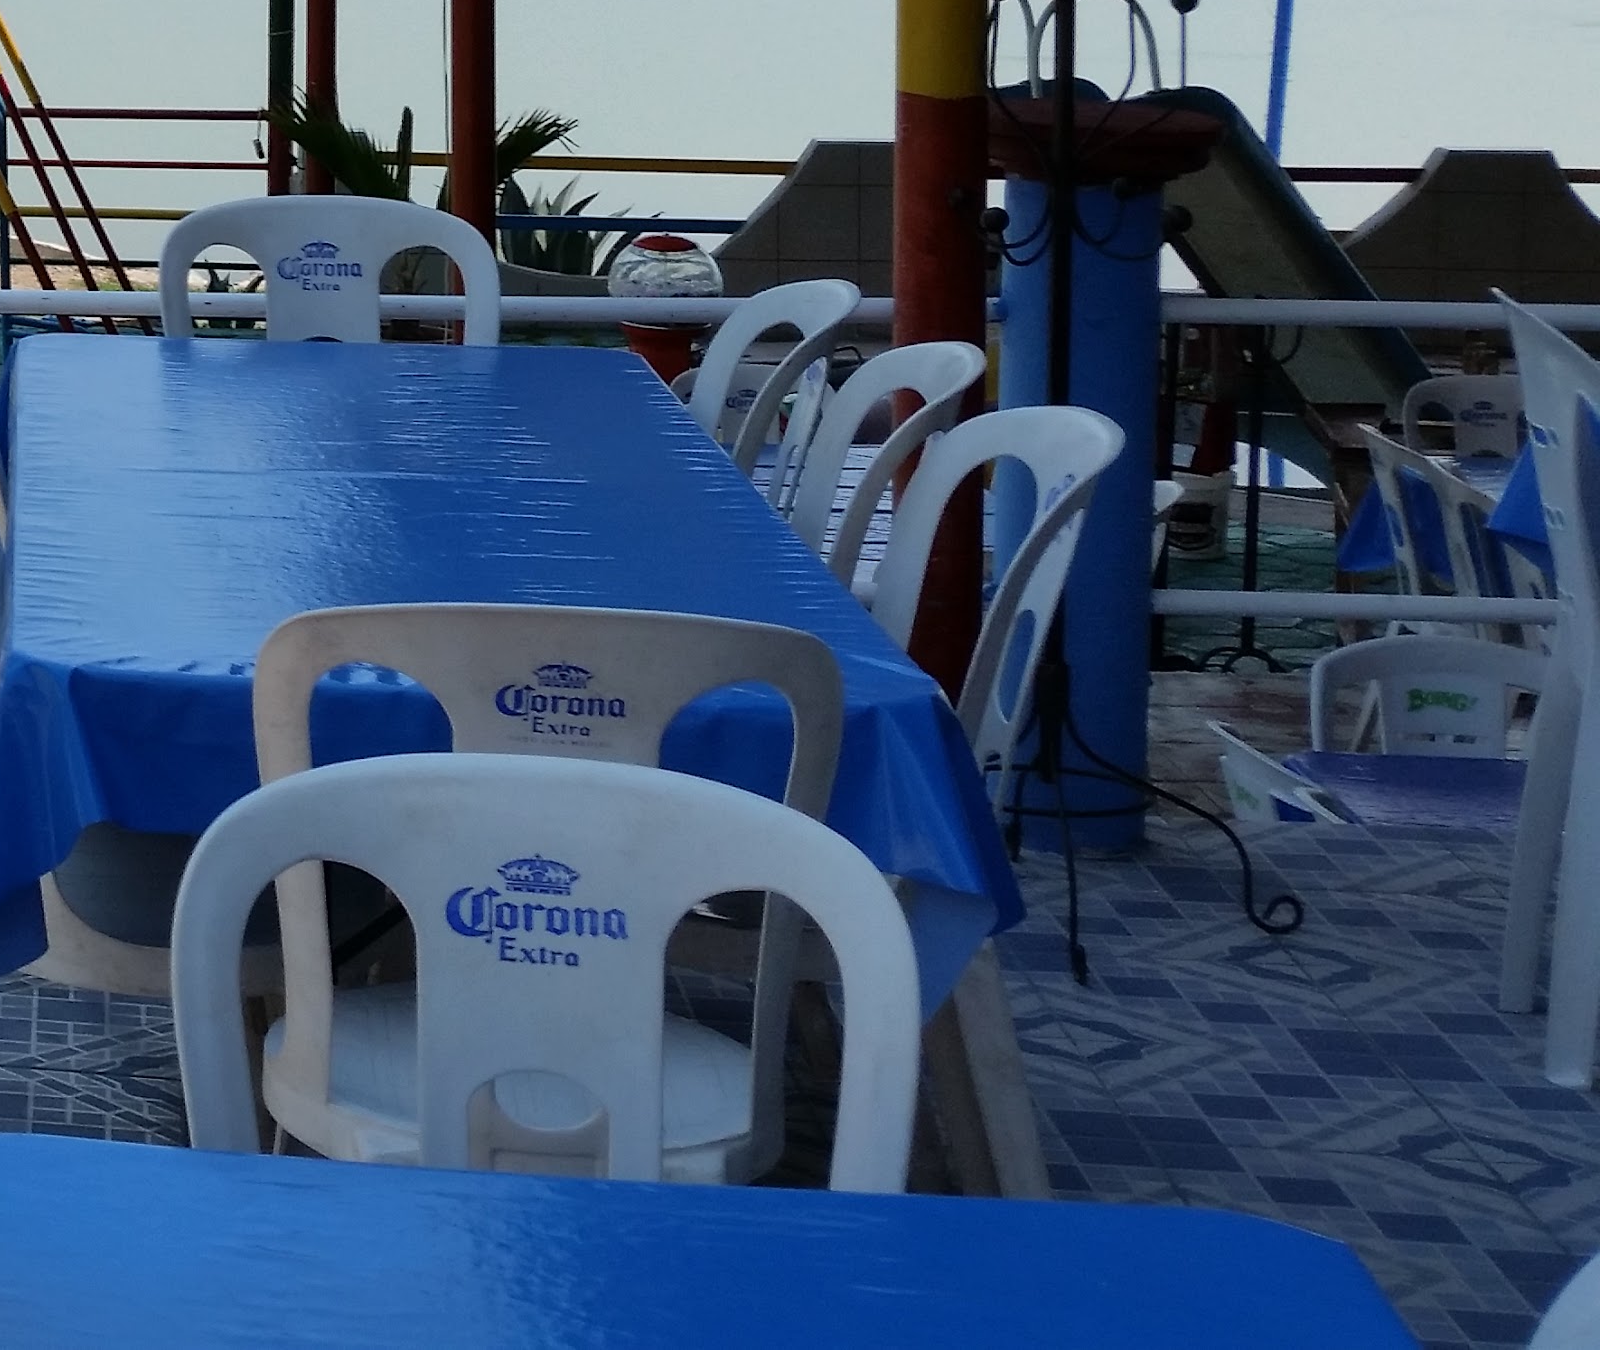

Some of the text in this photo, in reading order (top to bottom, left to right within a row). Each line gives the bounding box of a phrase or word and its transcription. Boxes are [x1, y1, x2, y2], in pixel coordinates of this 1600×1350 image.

[277, 256, 363, 283] Corona
[302, 278, 341, 291] Extra
[495, 684, 626, 721] Corona
[532, 716, 591, 737] Extra
[446, 886, 629, 943] Corona
[499, 936, 580, 967] Extra
